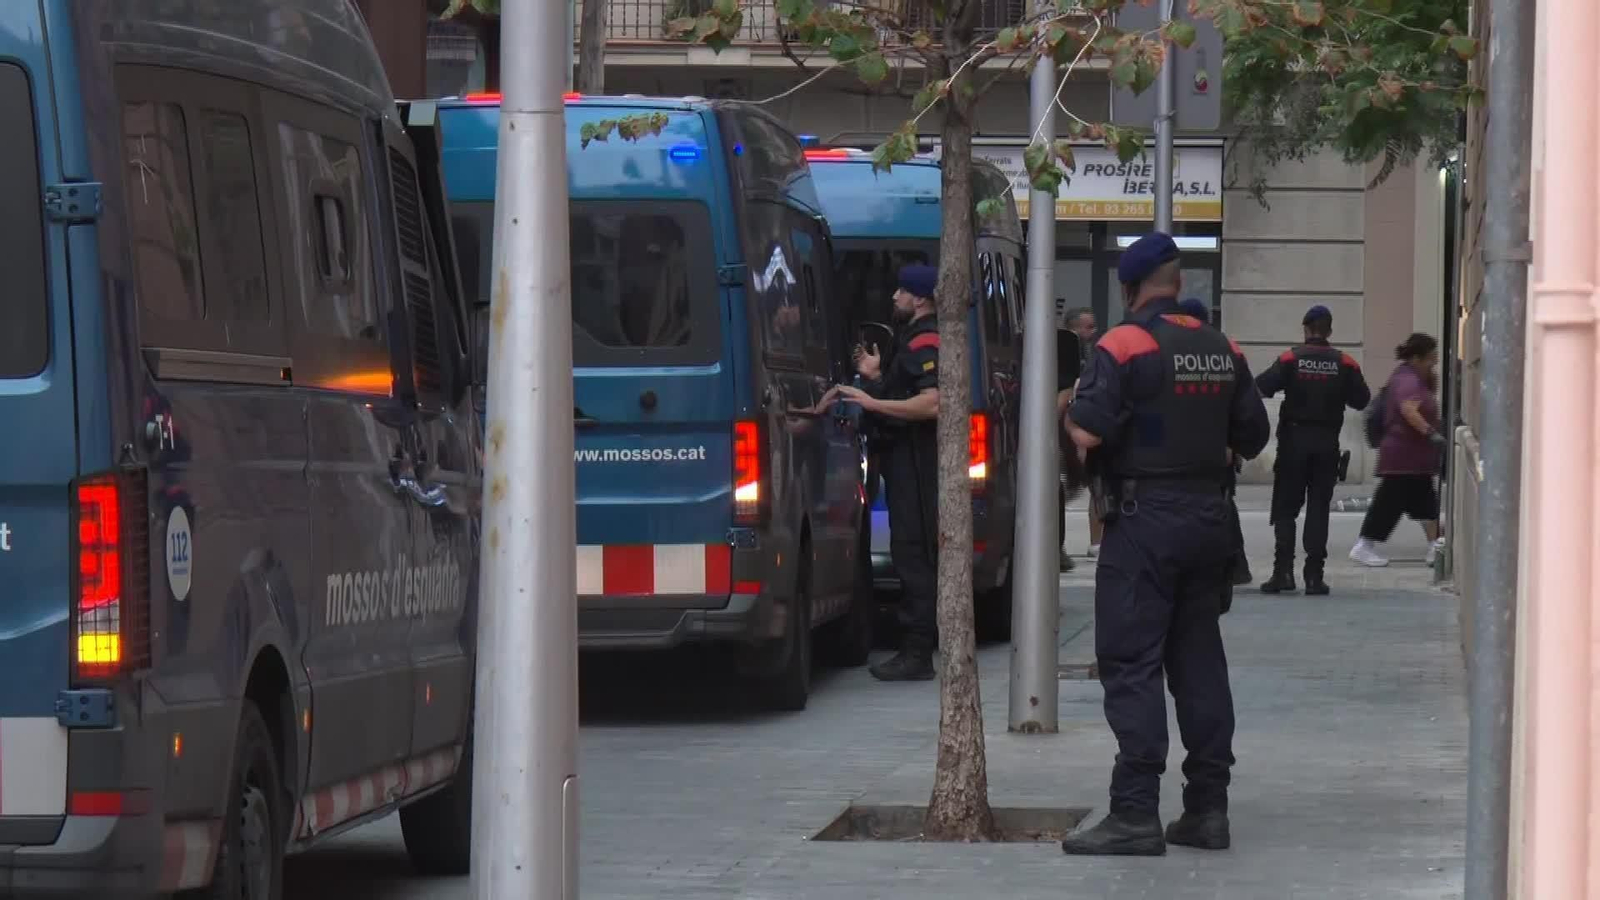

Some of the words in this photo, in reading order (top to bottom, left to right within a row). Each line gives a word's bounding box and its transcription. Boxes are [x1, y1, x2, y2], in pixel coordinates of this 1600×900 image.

[1173, 354, 1234, 371] POLICIA
[1298, 359, 1339, 370] POLICIA
[171, 531, 188, 563] 112
[326, 569, 389, 627] mossos
[390, 550, 461, 627] d'esquadra
